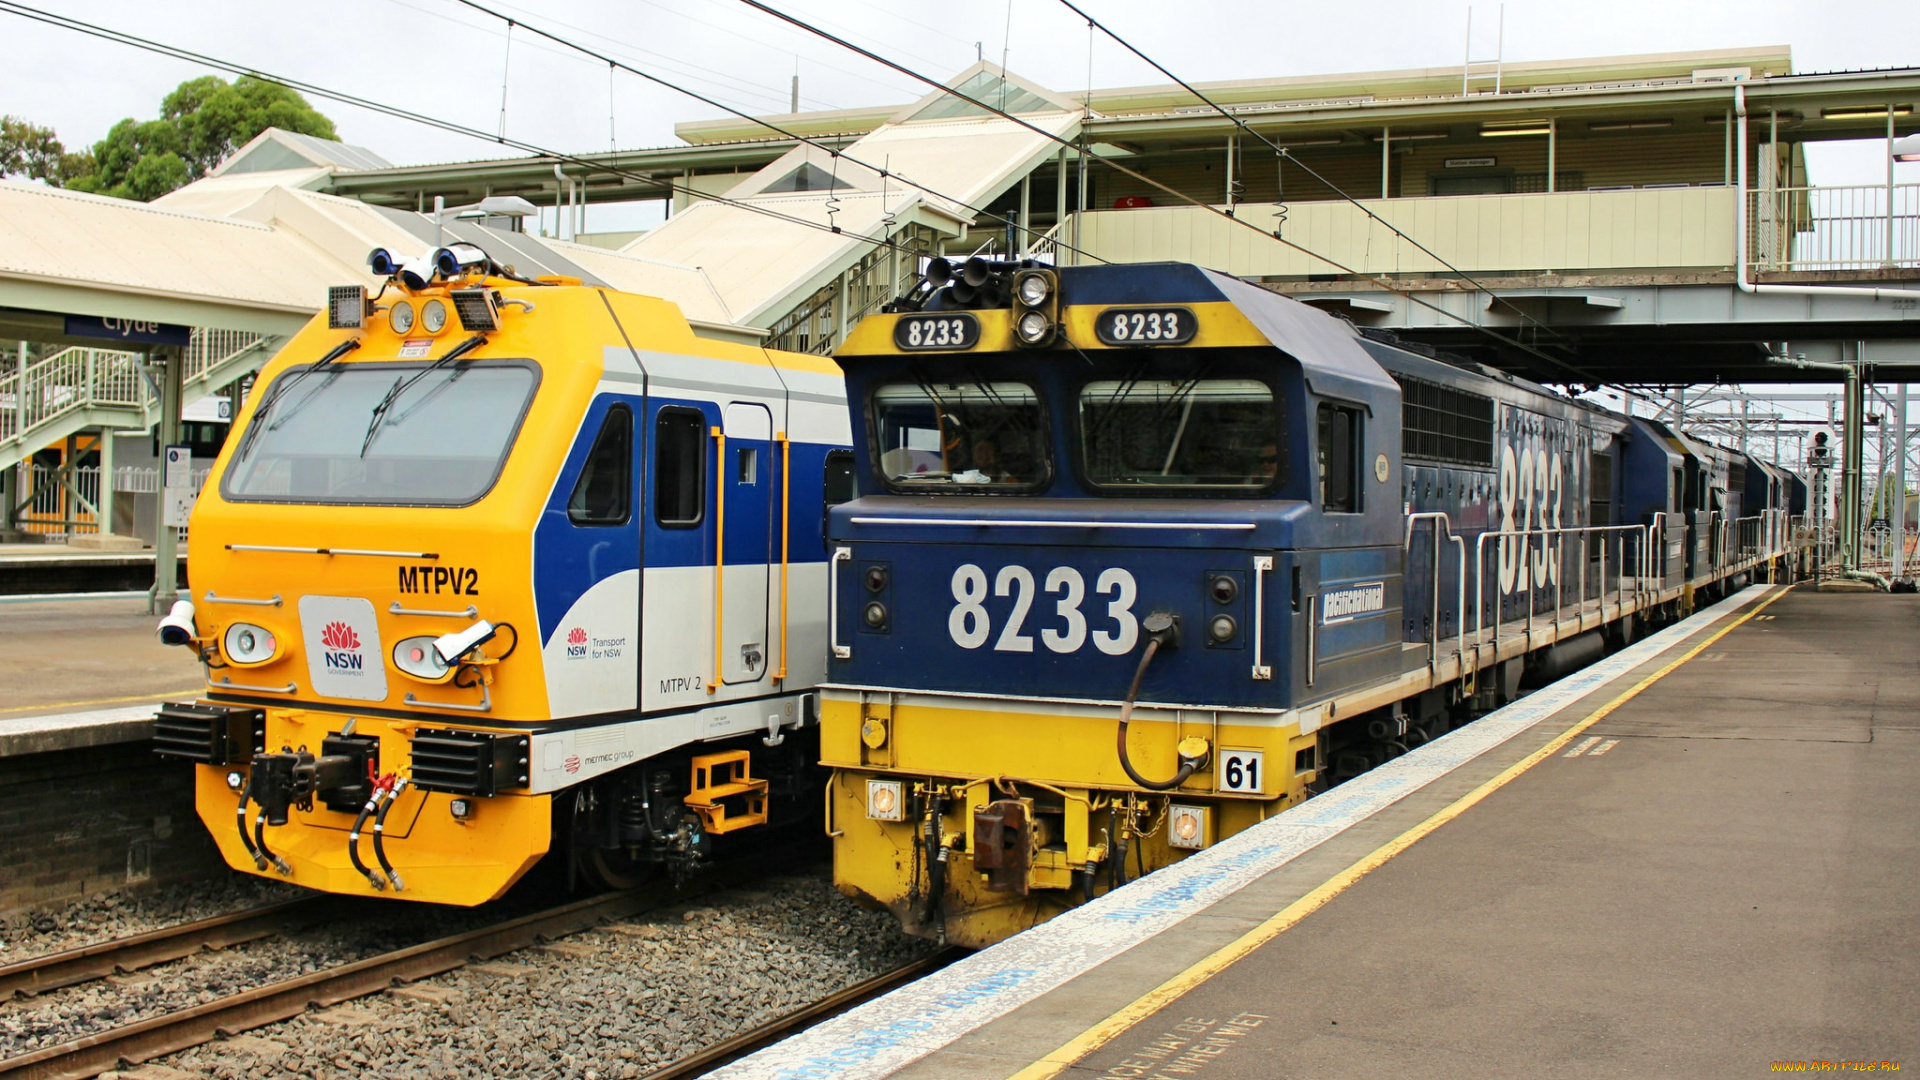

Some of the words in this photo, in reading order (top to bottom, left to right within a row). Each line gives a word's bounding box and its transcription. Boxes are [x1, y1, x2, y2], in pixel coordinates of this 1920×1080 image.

[908, 318, 965, 347] 8233
[1113, 312, 1179, 341] 8233
[1500, 445, 1562, 595] 8233
[398, 566, 479, 595] MTPV2
[948, 563, 1139, 656] 8233
[567, 645, 587, 656] NSW
[592, 637, 626, 648] Transport
[592, 649, 602, 659] for
[604, 648, 621, 658] NSW
[325, 651, 362, 670] NSW
[660, 678, 691, 694] MTPV
[695, 676, 701, 690] 2
[614, 750, 634, 762] group
[1225, 756, 1258, 791] 61
[1173, 1016, 1218, 1033] BE
[1213, 1011, 1270, 1036] WET
